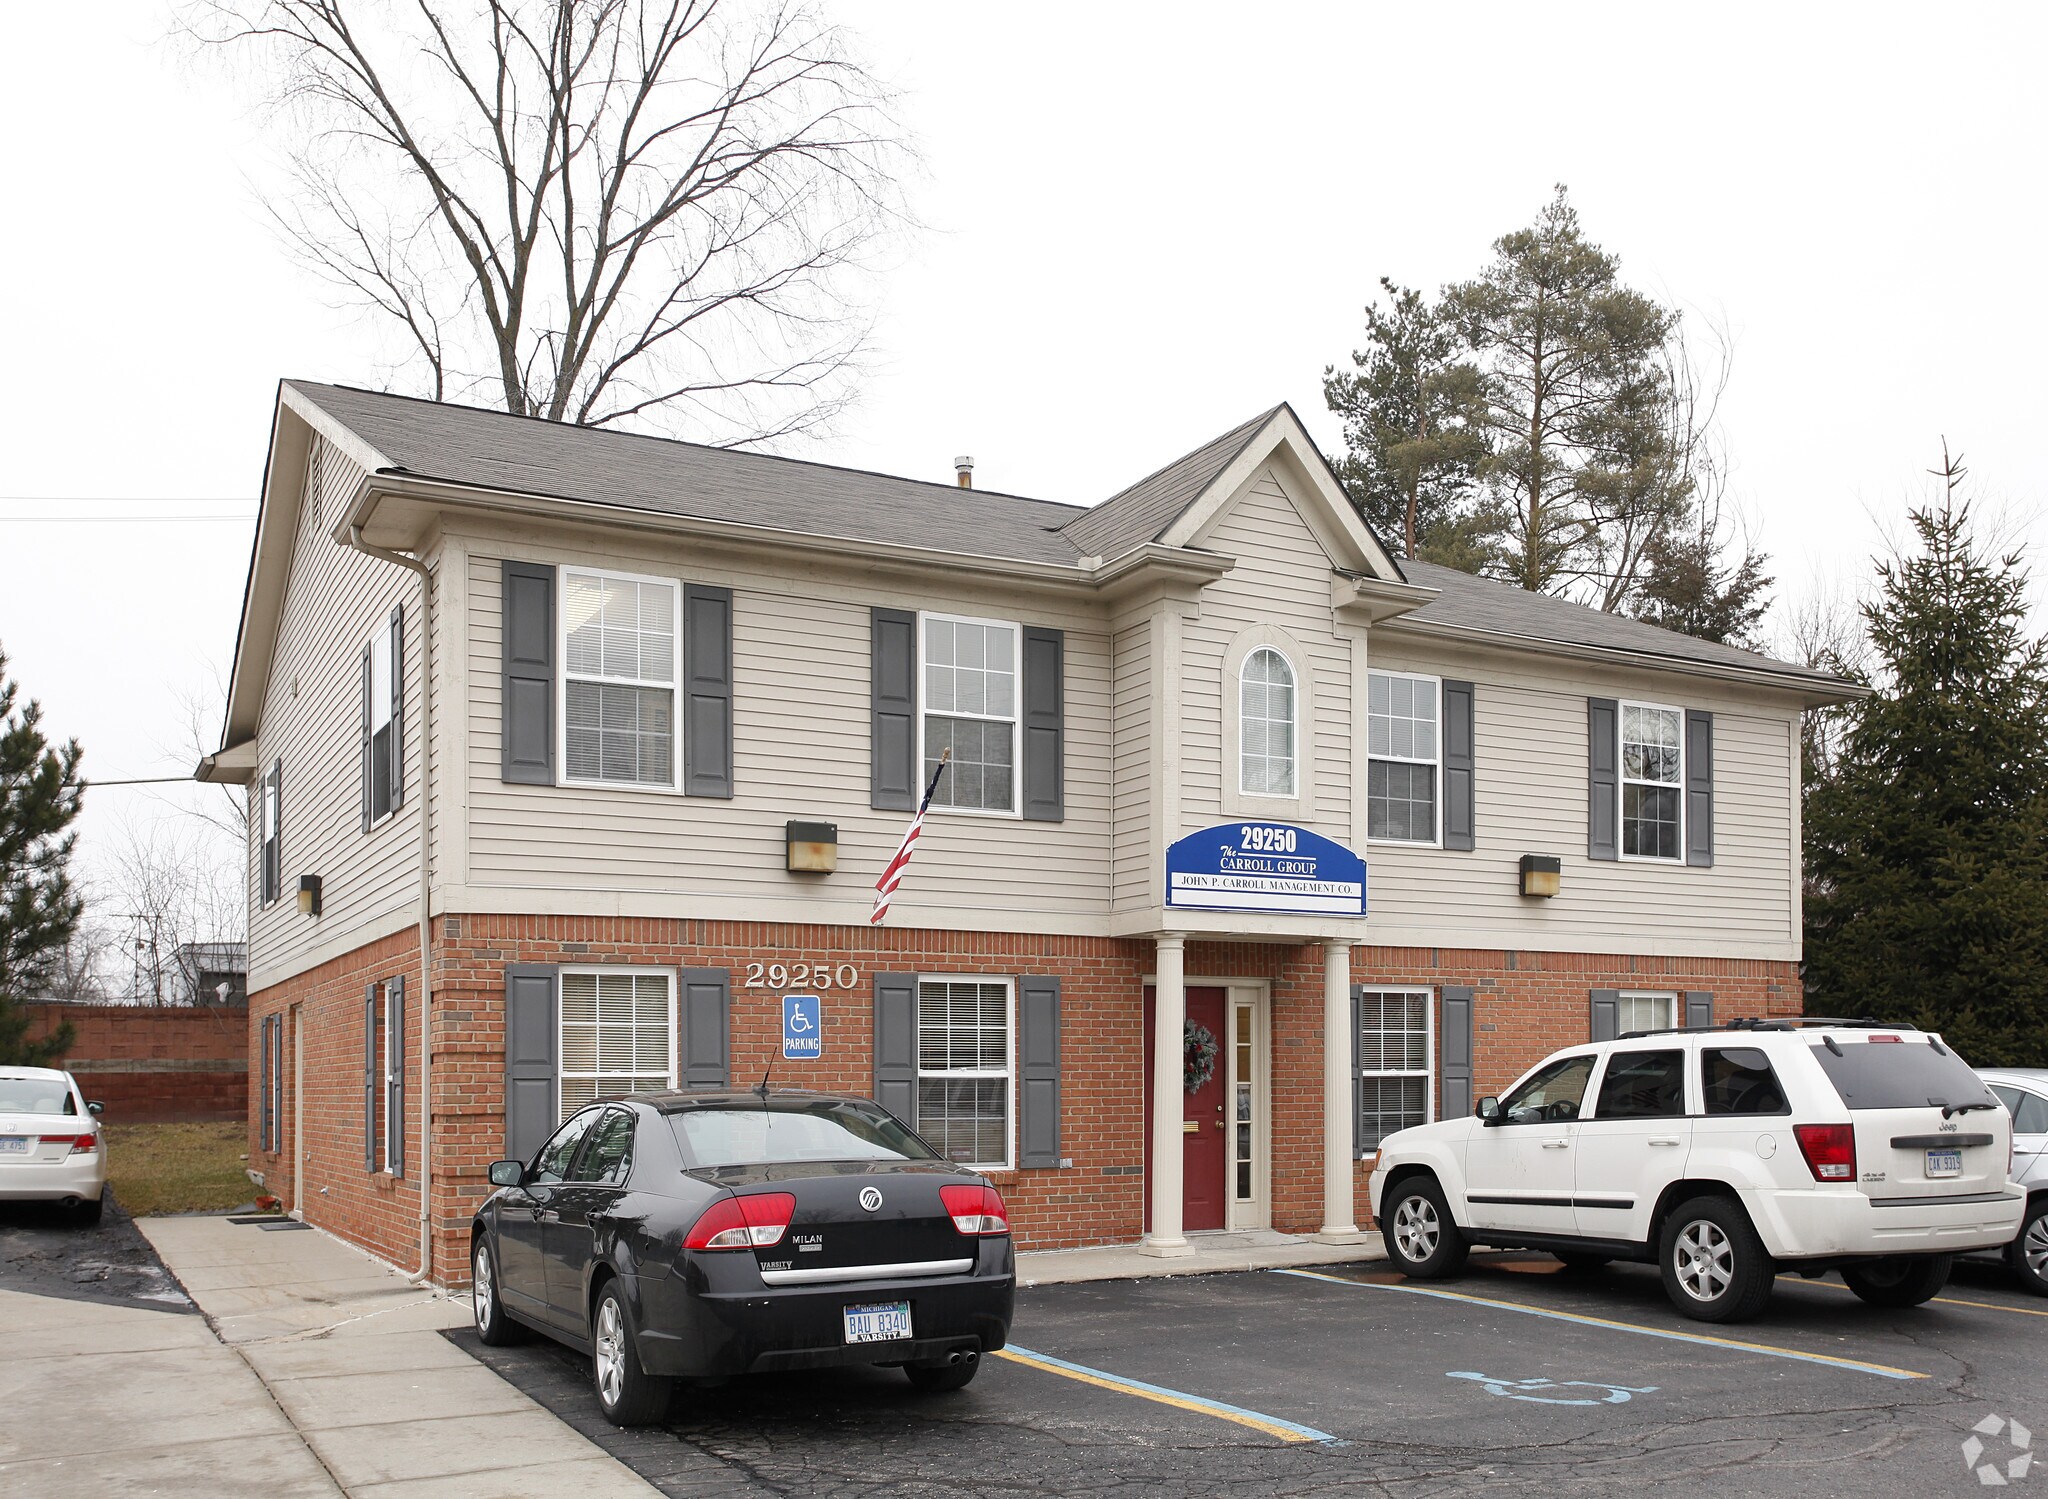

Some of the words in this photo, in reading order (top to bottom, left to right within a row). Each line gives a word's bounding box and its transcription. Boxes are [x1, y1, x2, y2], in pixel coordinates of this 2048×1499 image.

[1241, 826, 1296, 853] 29250
[1220, 845, 1237, 857] The
[1220, 857, 1274, 872] CARROLL
[1277, 861, 1317, 875] GROUP
[1181, 875, 1208, 886] JOHN
[1211, 877, 1220, 887] P.
[1223, 878, 1266, 890] CARROLL
[1269, 880, 1335, 893] MANAGEMENT
[1337, 884, 1353, 894] CO.
[745, 963, 858, 989] 29250
[786, 1038, 819, 1050] PARKING
[1939, 1122, 1957, 1132] Jeep
[792, 1235, 823, 1244] MILAN
[760, 1261, 793, 1271] VARSITY
[860, 1305, 893, 1313] MICHIGAN
[849, 1315, 871, 1335] BAU
[878, 1313, 907, 1332] 8340
[860, 1332, 899, 1342] VARSITY
